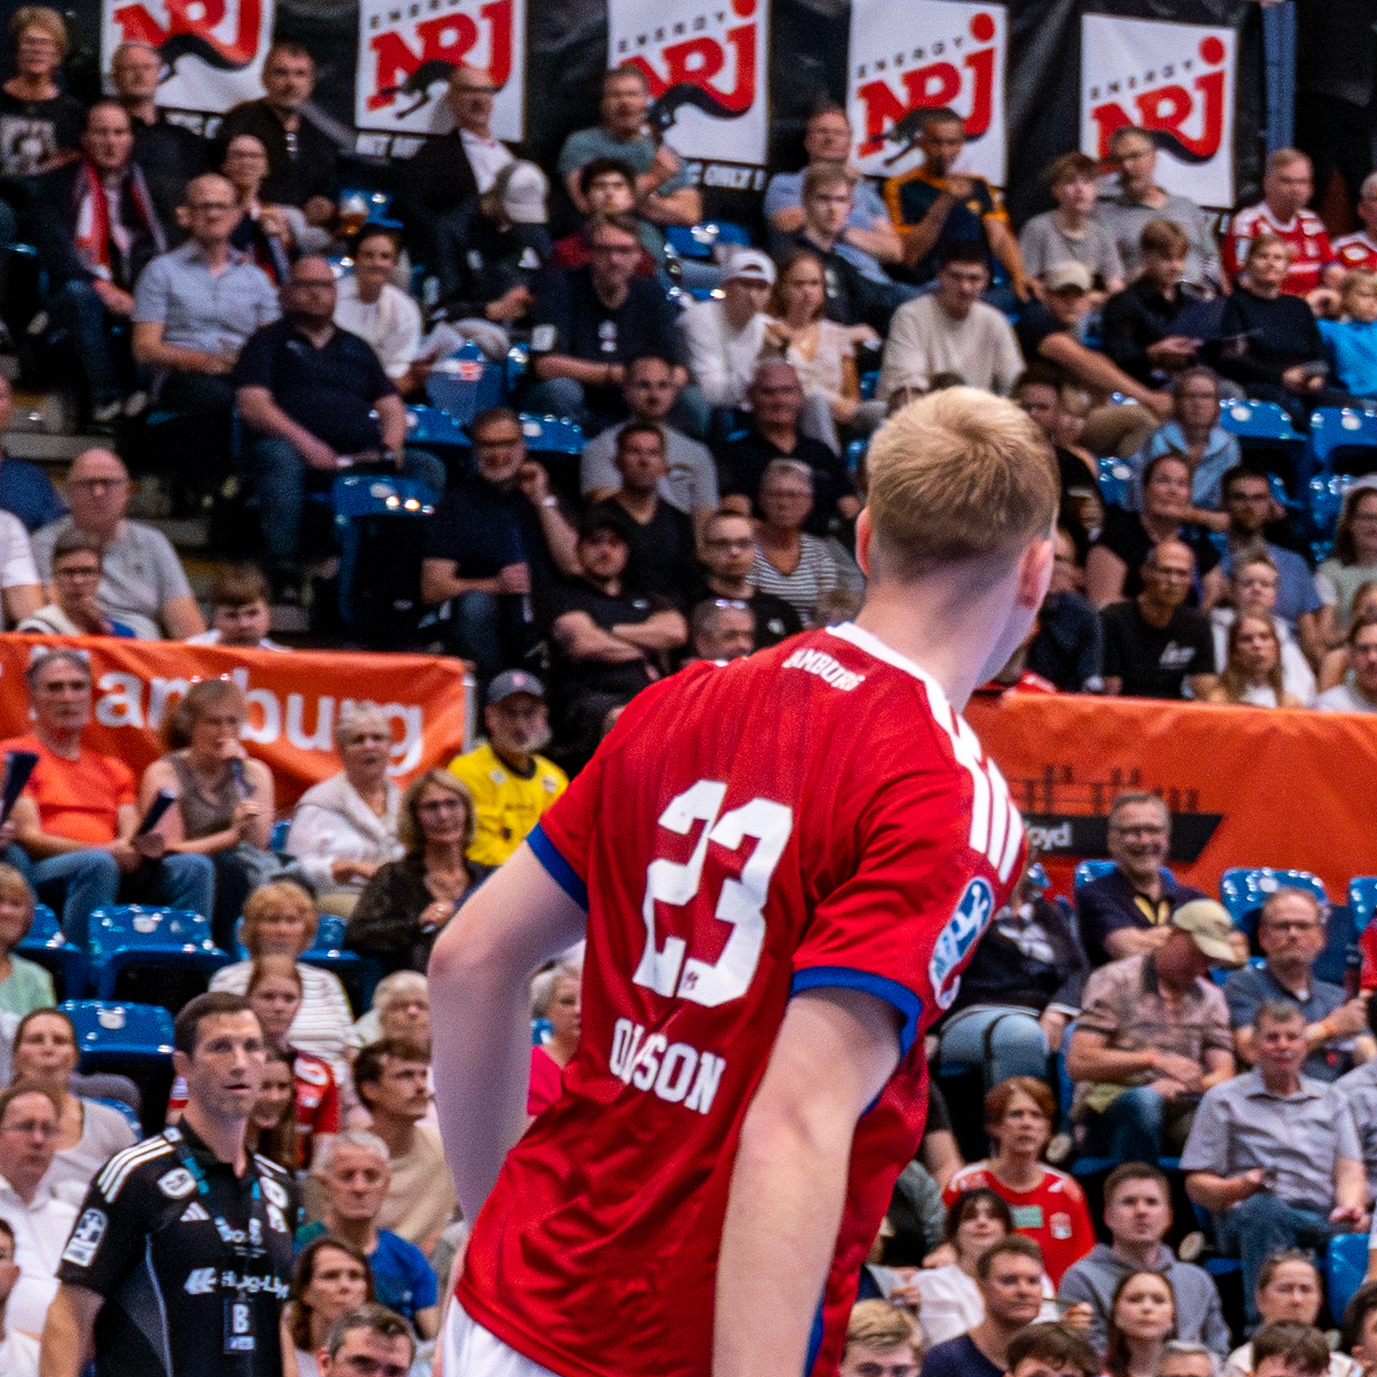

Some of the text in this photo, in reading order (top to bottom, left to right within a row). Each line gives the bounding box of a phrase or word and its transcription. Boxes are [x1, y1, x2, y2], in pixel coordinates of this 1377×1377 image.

[367, 0, 513, 112] NRJ
[857, 13, 996, 158] NRJ
[1091, 36, 1226, 176] NRJ
[633, 780, 793, 1008] 23
[232, 1303, 250, 1334] B
